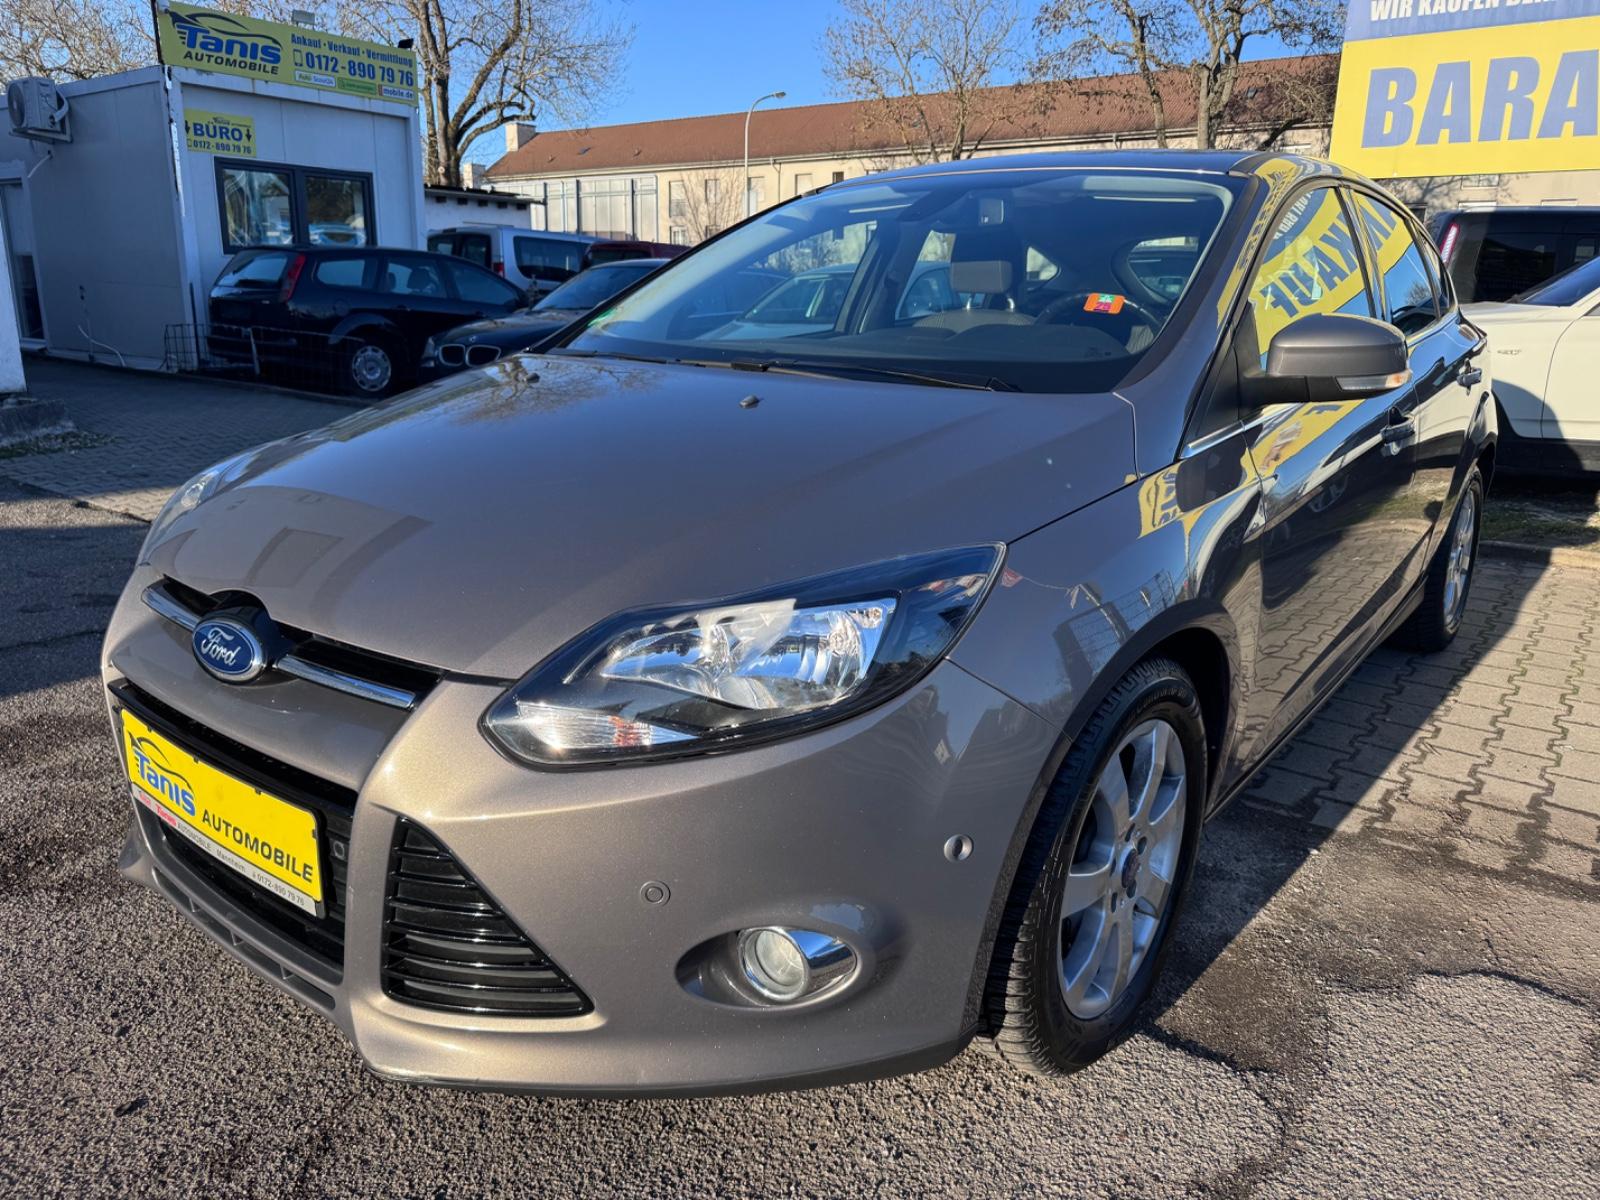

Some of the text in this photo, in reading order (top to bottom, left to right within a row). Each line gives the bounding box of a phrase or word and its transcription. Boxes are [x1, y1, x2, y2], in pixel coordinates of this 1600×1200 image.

[1370, 0, 1413, 22] WIR
[291, 34, 322, 49] Ankauf
[327, 41, 360, 57] Verkauf
[183, 50, 279, 76] AUTOMOBILE
[379, 65, 395, 84] 79
[398, 69, 413, 87] 76
[1361, 49, 1600, 148] BARA
[193, 120, 243, 142] BÜRO
[200, 626, 242, 666] Ford
[202, 808, 314, 884] AUTOMOBILE
